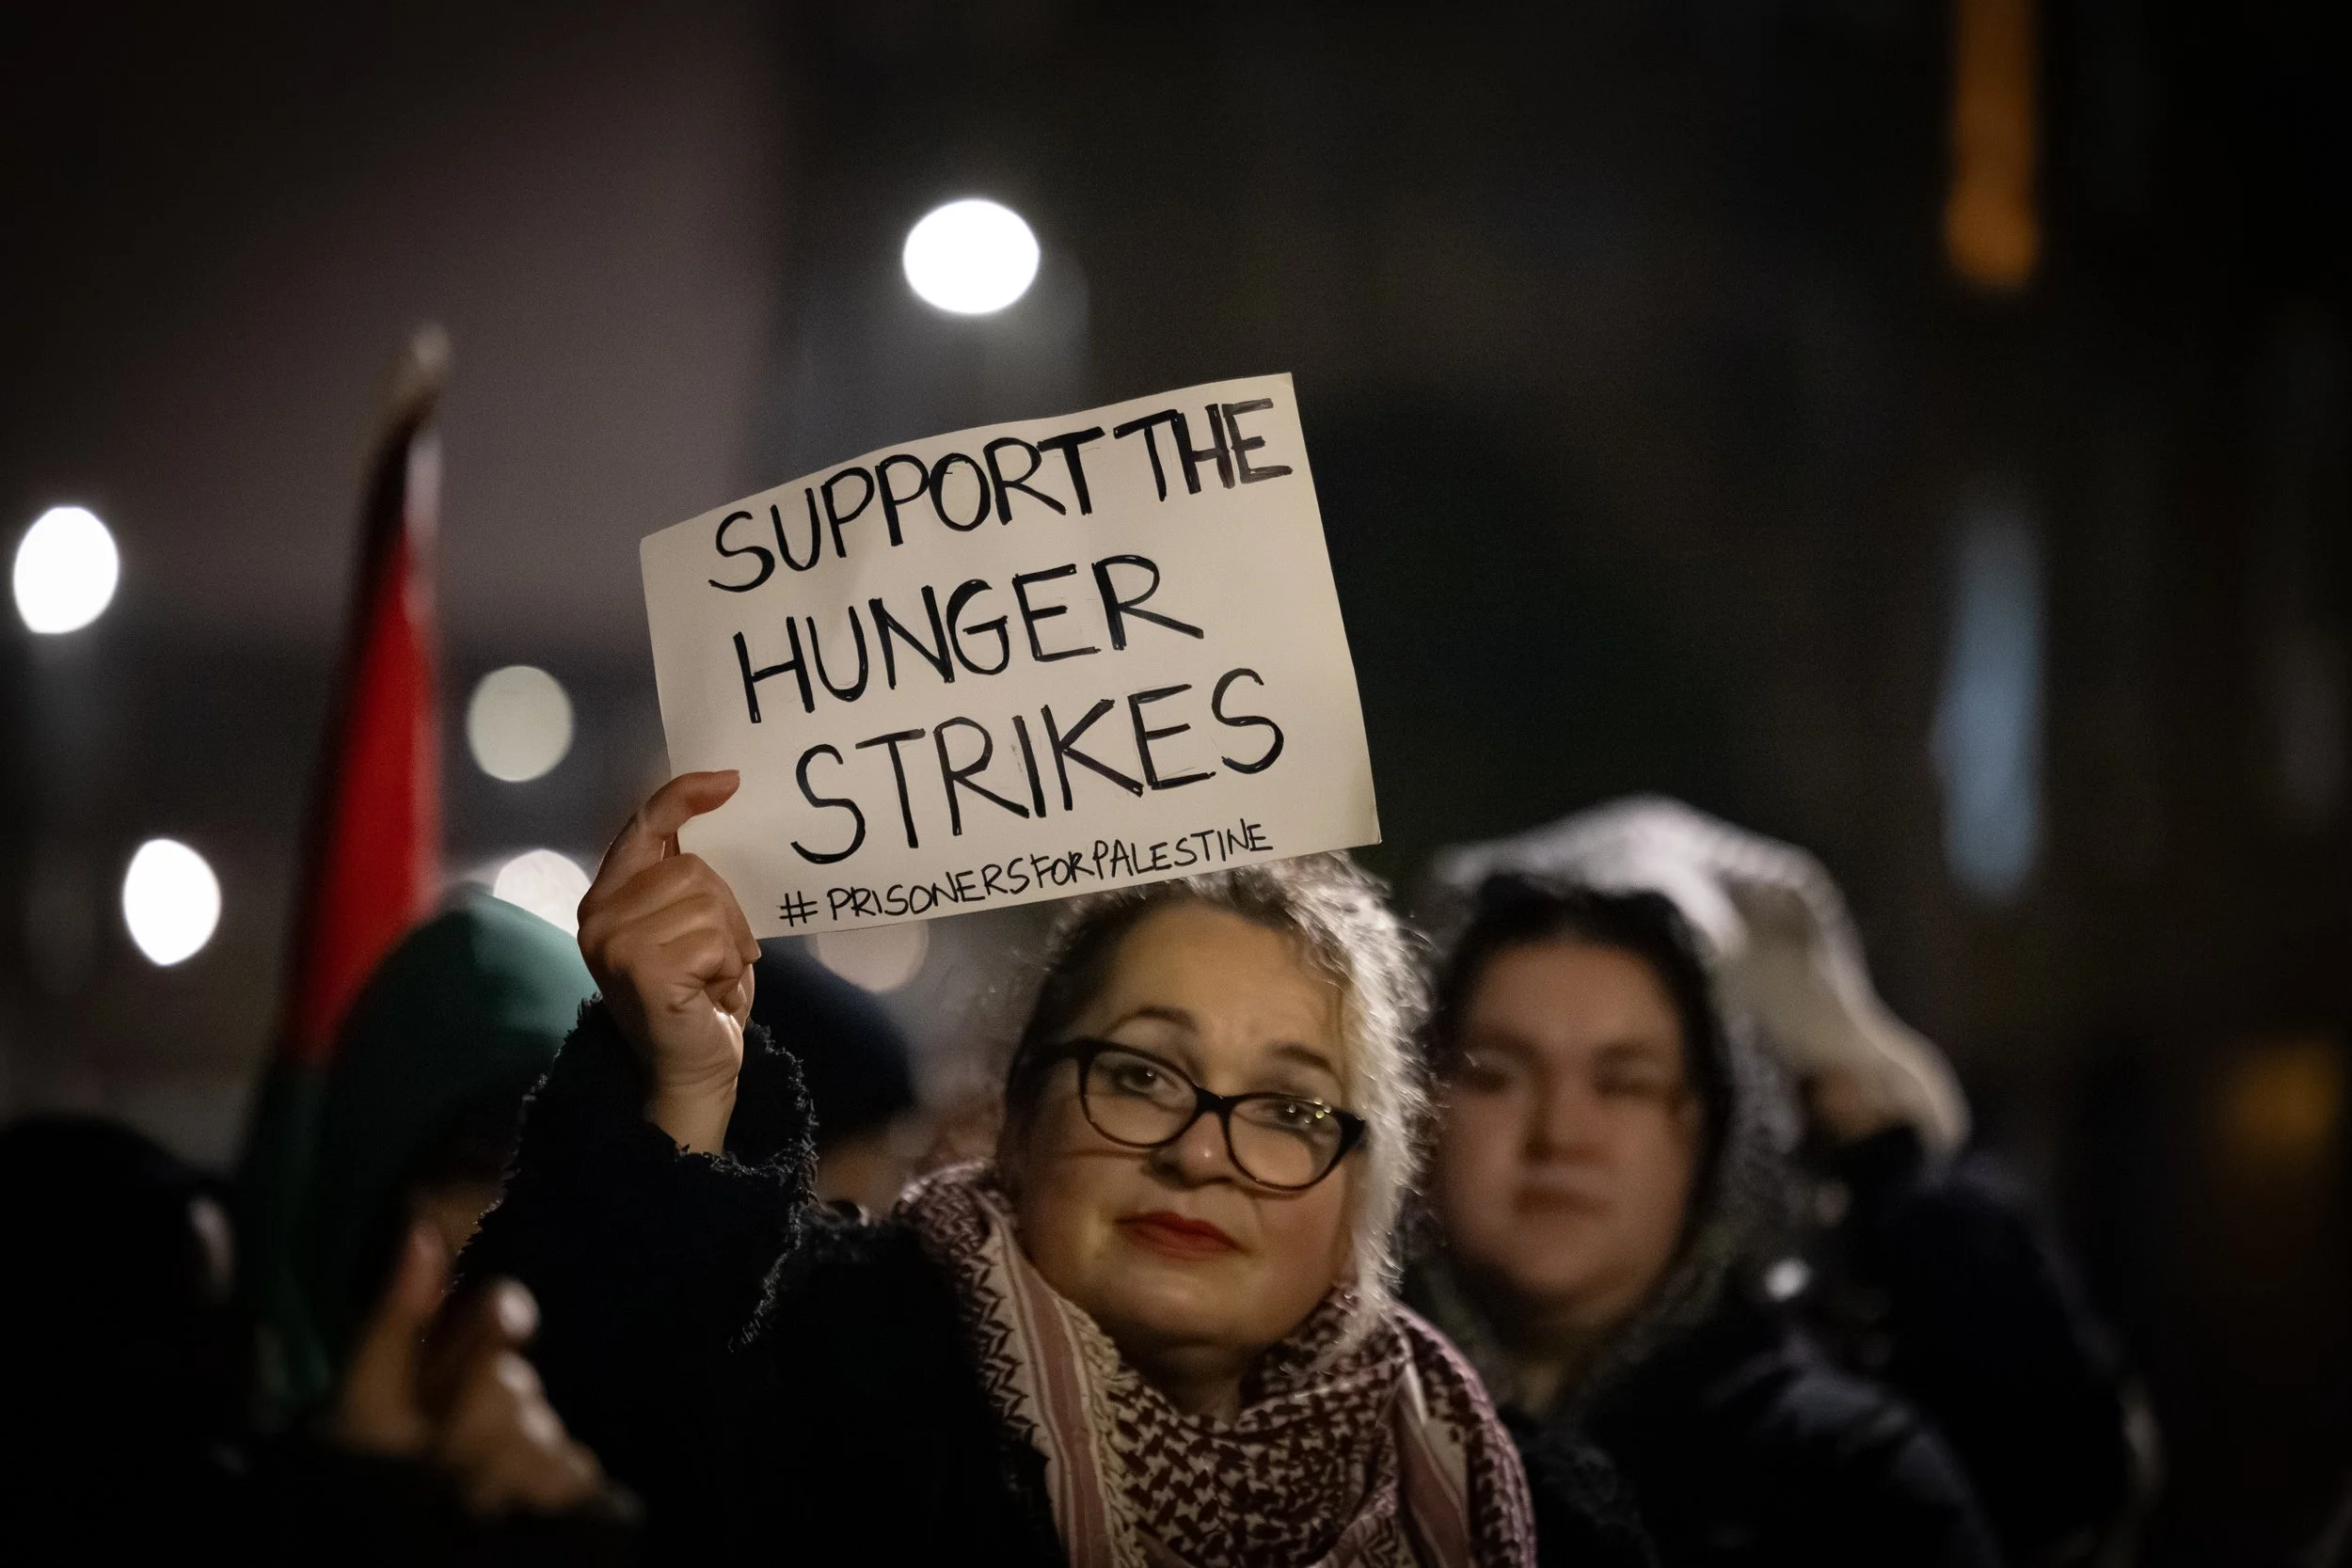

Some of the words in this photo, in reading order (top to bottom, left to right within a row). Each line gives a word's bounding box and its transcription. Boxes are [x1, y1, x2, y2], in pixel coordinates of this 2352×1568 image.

[708, 426, 1106, 593] SUPPORT
[1114, 398, 1293, 501] THE
[733, 555, 1204, 723] HUNGER
[790, 668, 1284, 864] STRIKES
